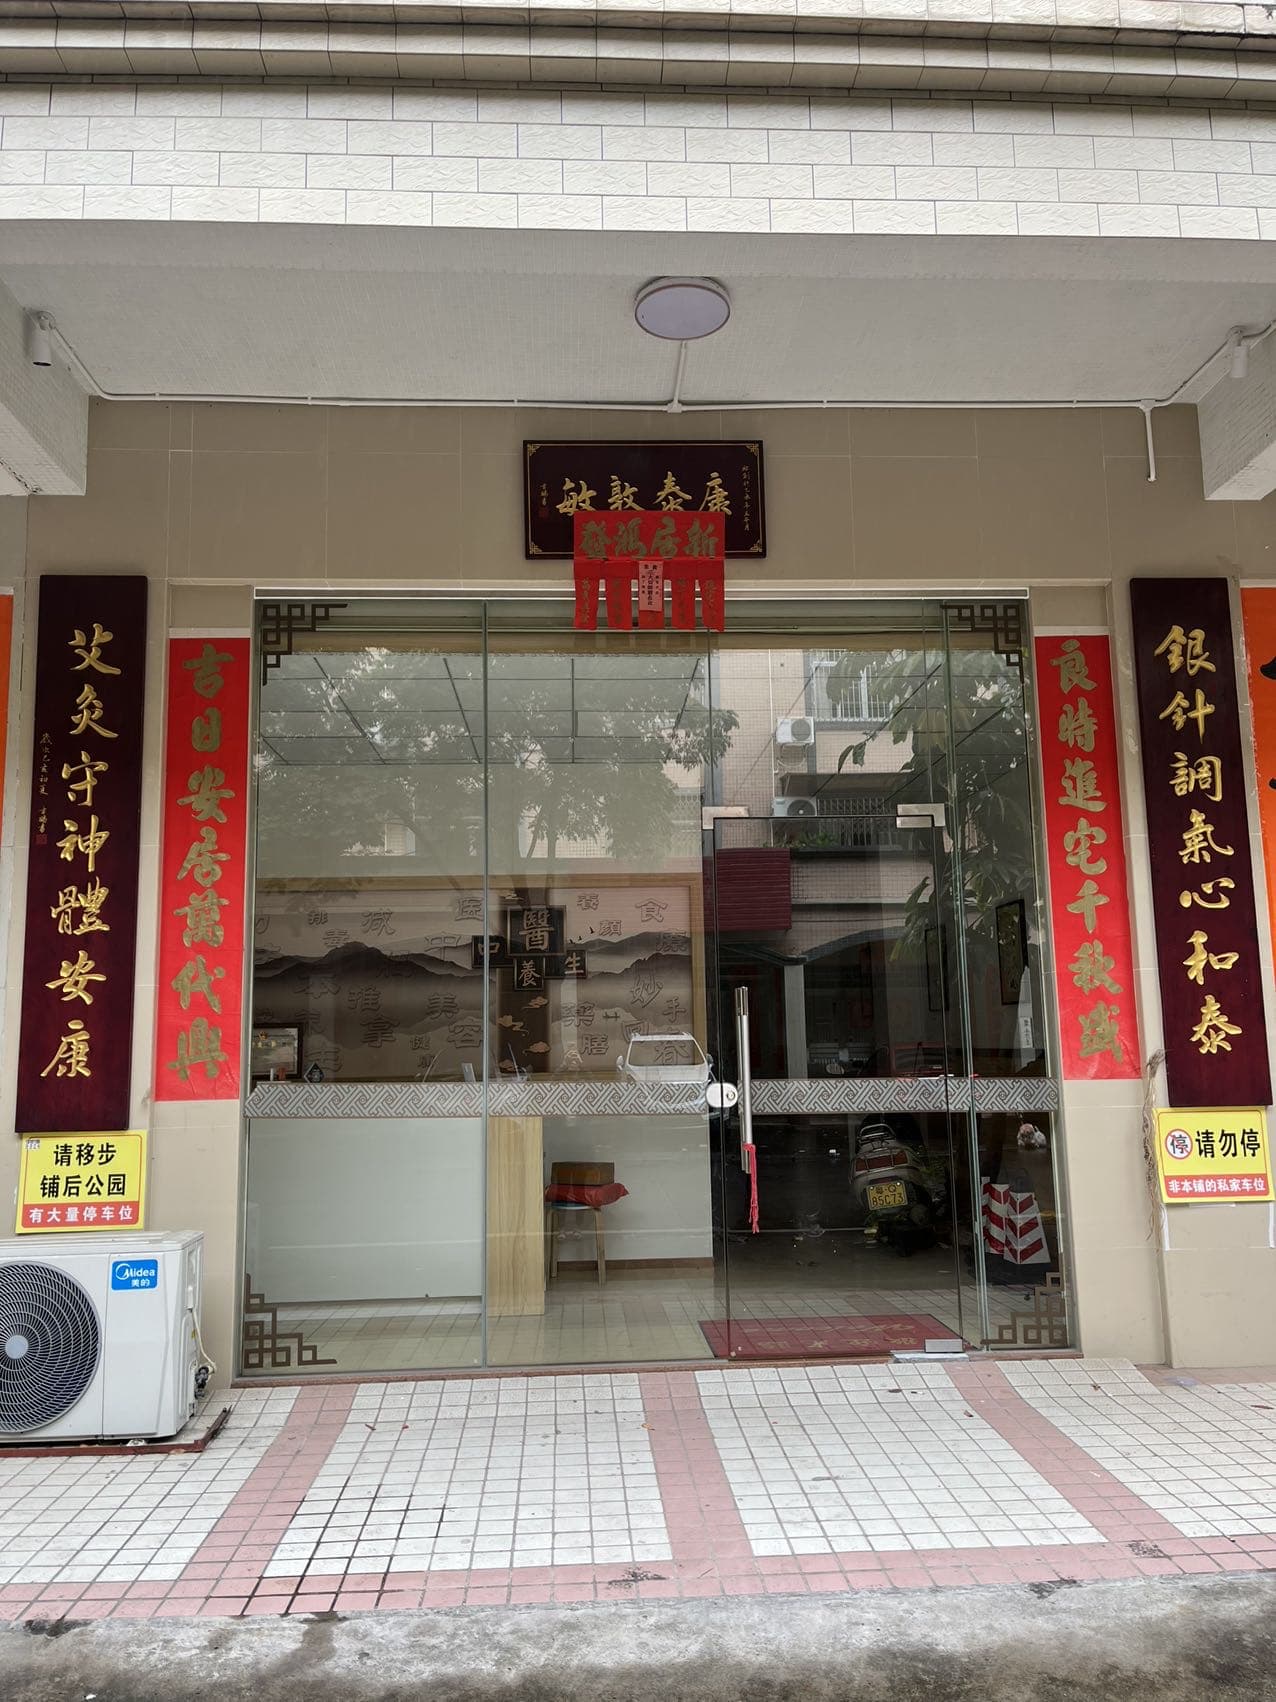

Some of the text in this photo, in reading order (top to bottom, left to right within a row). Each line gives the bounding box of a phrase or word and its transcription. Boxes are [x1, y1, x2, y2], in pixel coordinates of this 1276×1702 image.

[1195, 1128, 1260, 1159] 请勿停
[53, 1142, 117, 1167] 请移步
[40, 1174, 126, 1198] 铺后公园
[1168, 1178, 1265, 1193] 非本铺的私家车位
[29, 1205, 133, 1223] 有大量停车位
[116, 1263, 155, 1280] Midea
[131, 1279, 150, 1287] 美的
